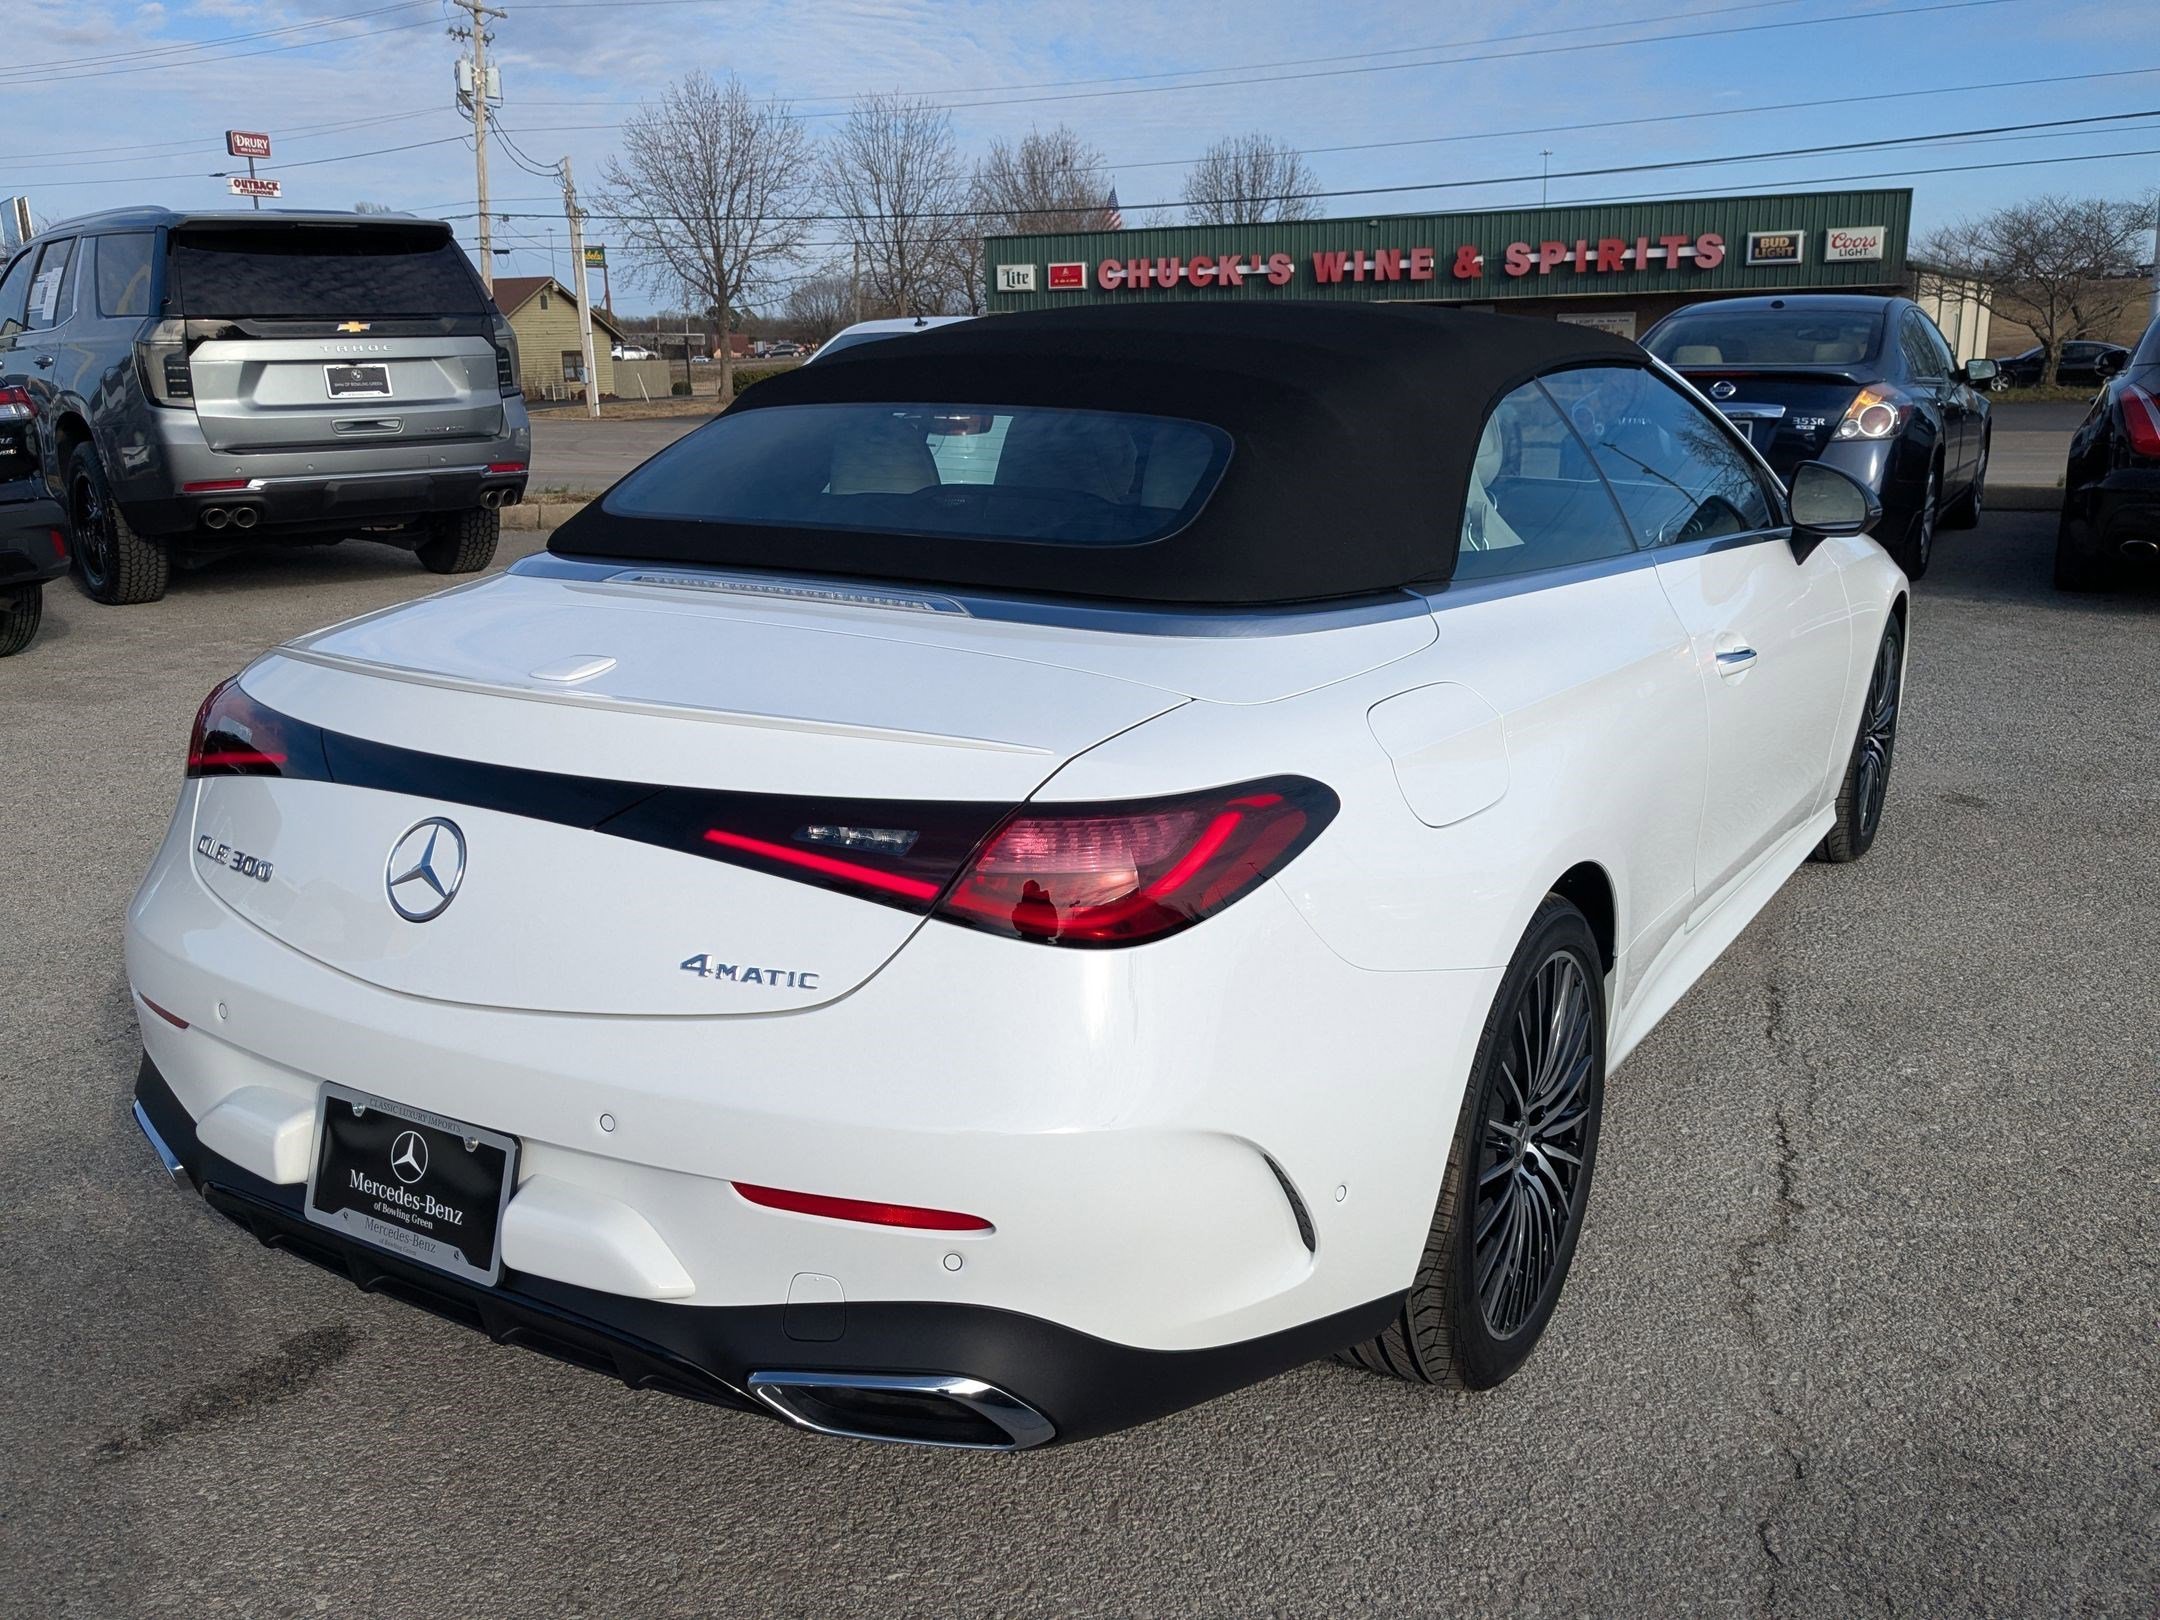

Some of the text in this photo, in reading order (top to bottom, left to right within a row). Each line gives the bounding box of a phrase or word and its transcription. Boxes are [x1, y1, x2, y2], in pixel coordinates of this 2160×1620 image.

[234, 134, 268, 149] DRURY
[234, 179, 279, 191] OUTBACK
[1760, 237, 1790, 248] BUD
[1831, 232, 1877, 249] Coors
[1754, 246, 1795, 258] LIGHT
[1839, 248, 1869, 257] LIGHT
[1098, 232, 1724, 290] CHUCK'S WINE & SPIRITS
[1006, 271, 1029, 288] Lite
[320, 344, 393, 353] TAHOE
[1810, 417, 1826, 426] SR
[197, 834, 274, 883] CLE 300
[680, 953, 820, 990] 4MATIC
[370, 1098, 463, 1134] CLASSIC LUXURY IMPORTS
[349, 1169, 463, 1226] Mercedes-Benz
[373, 1202, 434, 1230] of Bowling Green
[365, 1217, 437, 1254] Mercedes-Benz
